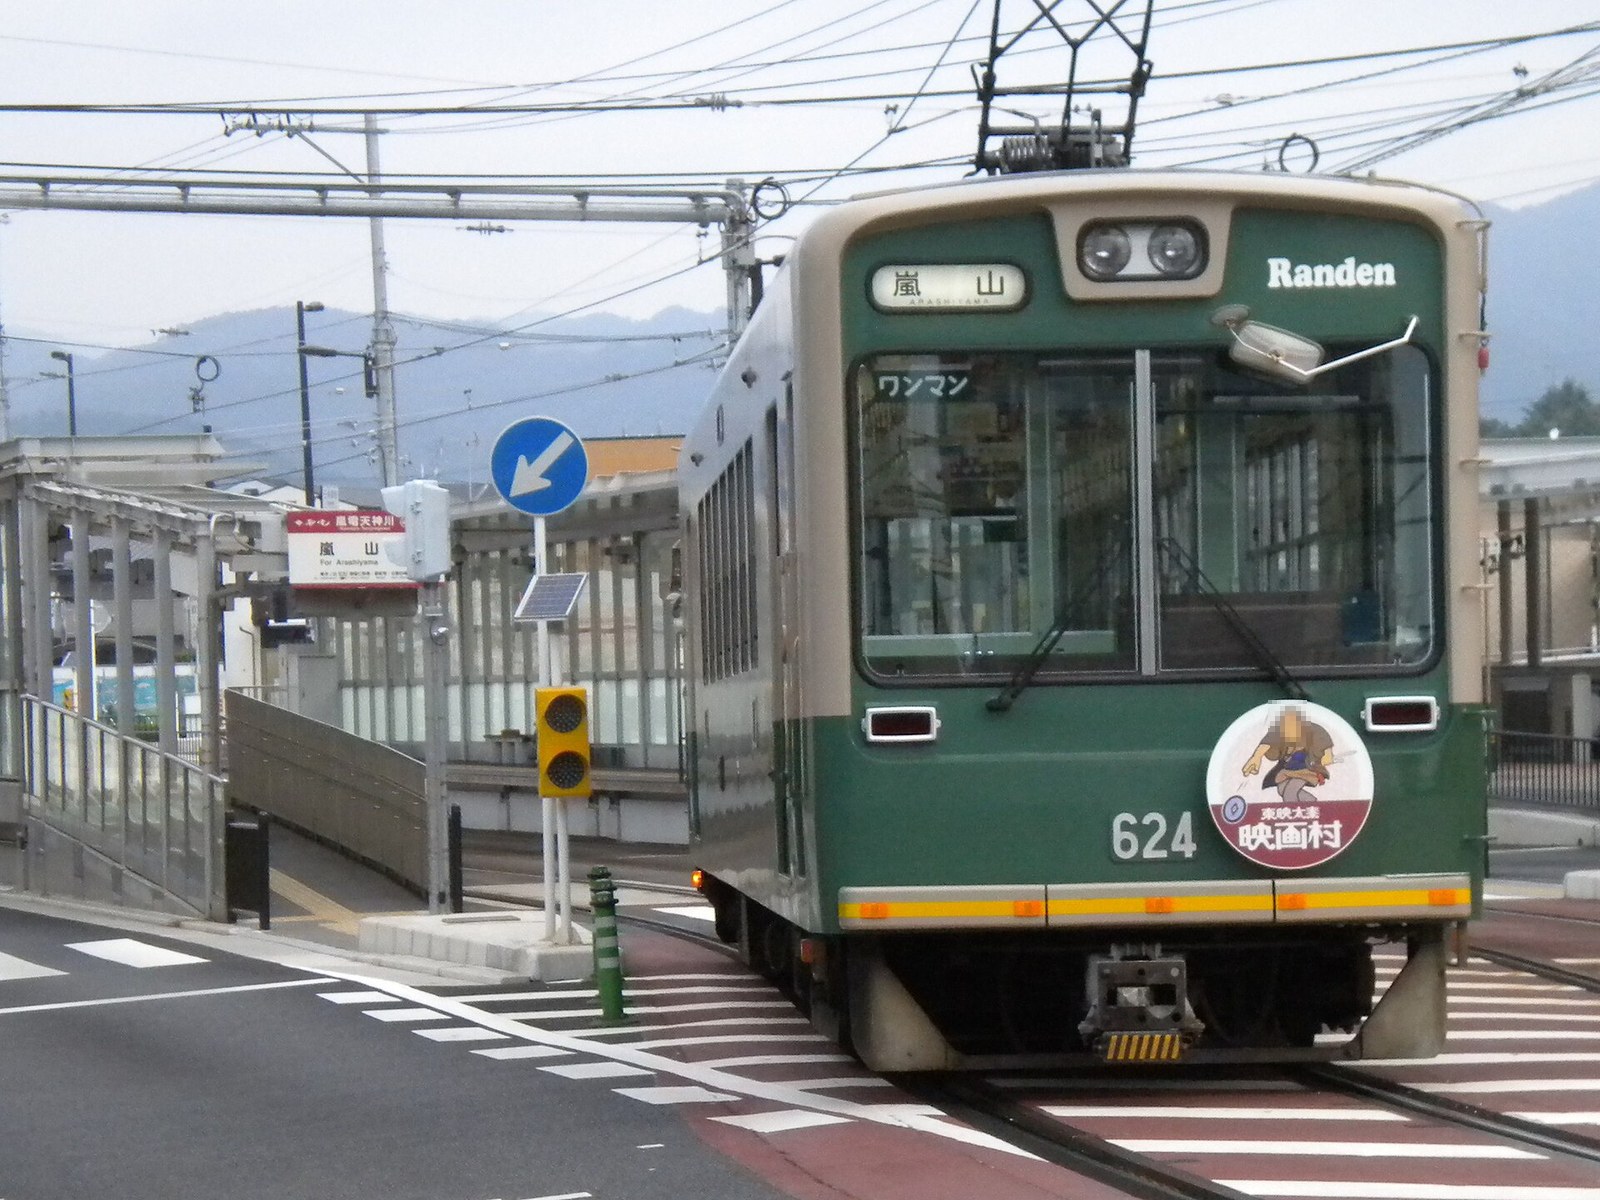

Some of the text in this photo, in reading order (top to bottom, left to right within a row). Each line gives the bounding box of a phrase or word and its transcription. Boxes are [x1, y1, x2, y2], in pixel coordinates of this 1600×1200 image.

[893, 270, 1005, 297] 嵐山
[1267, 256, 1396, 288] Randen
[879, 375, 968, 397] ワンマン
[320, 541, 379, 556] 嵐山
[1112, 811, 1197, 859] 624
[1238, 820, 1343, 851] 映画村
